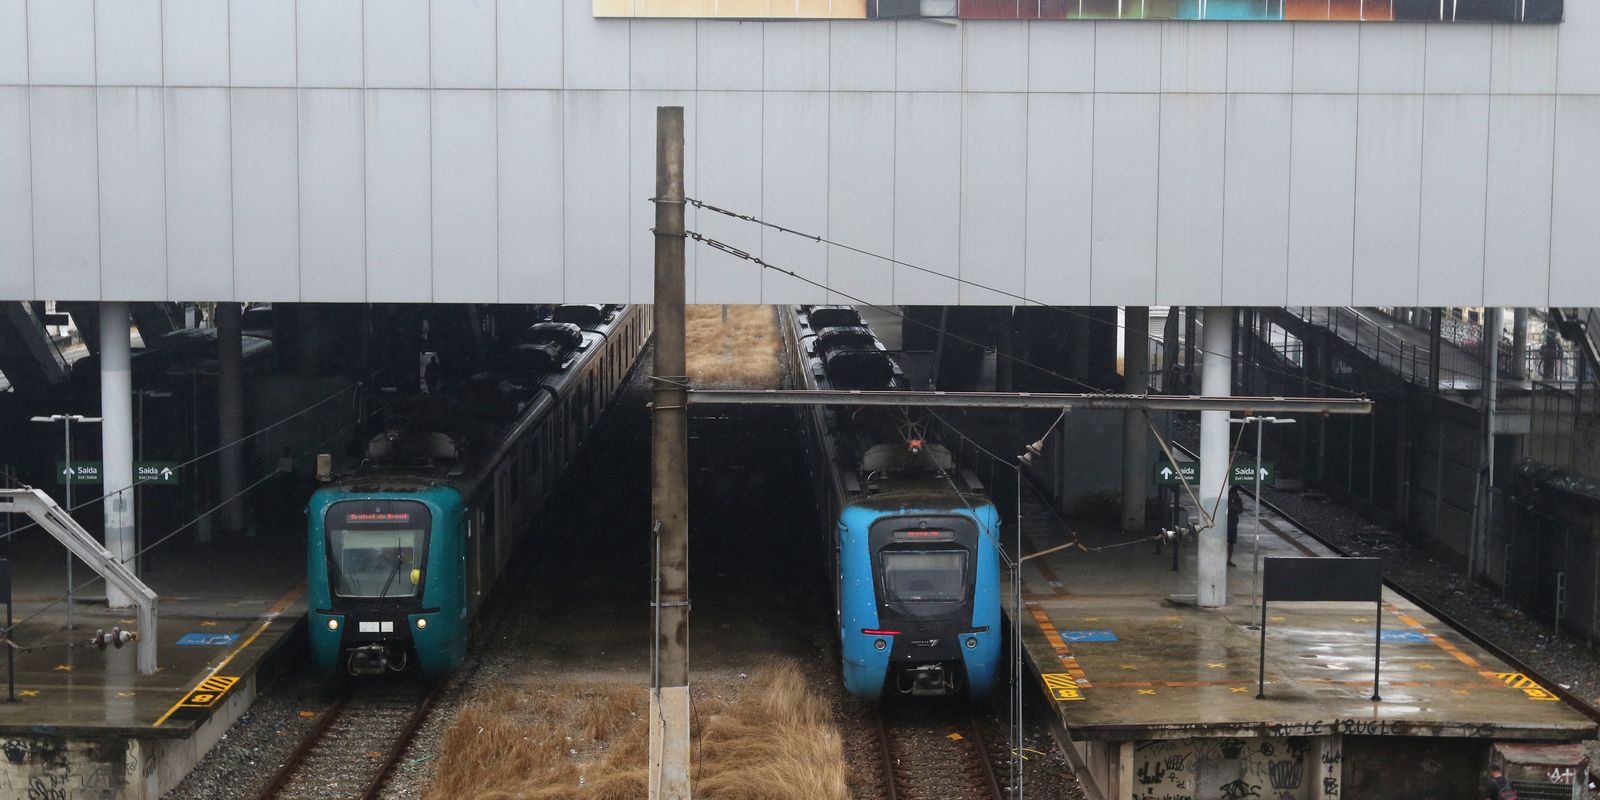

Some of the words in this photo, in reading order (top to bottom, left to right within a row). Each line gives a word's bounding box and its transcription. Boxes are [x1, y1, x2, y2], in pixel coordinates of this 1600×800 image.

[77, 466, 97, 474] Saída
[138, 466, 158, 474] Saída
[1235, 467, 1254, 475] Saída
